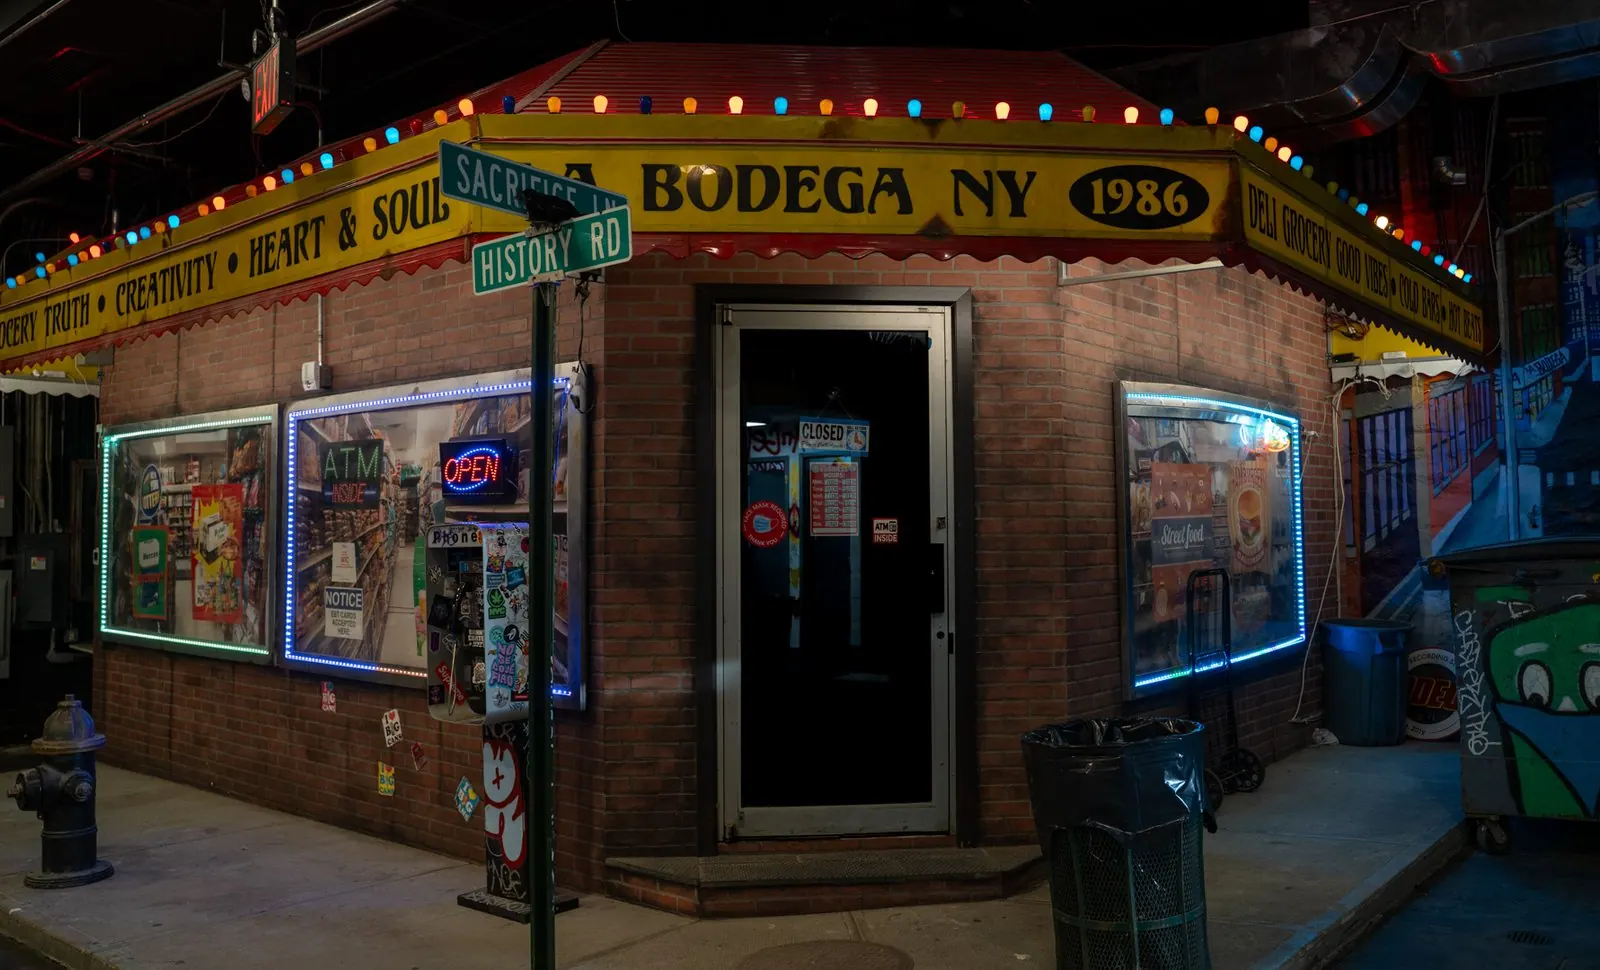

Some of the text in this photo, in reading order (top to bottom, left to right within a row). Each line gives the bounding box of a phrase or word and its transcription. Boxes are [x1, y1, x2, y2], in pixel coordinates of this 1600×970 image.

[255, 46, 279, 124] EXIT
[457, 154, 577, 209] SACRI
[641, 163, 914, 215] BODEGA
[951, 169, 1037, 218] NY
[1091, 178, 1189, 217] 1986
[44, 293, 90, 338] TRUTH
[116, 252, 217, 317] CREATIVITY
[249, 216, 326, 278] HEART
[338, 207, 358, 251] &
[373, 177, 450, 240] SOUL
[482, 217, 621, 287] HISTORY RD
[1248, 183, 1278, 241] DELI
[1283, 204, 1331, 269] GROCERY
[1336, 236, 1361, 285] GOOD
[1364, 252, 1388, 298] VIBES
[1400, 273, 1420, 314] COLD
[1421, 285, 1441, 325] BARS
[802, 423, 844, 441] CLOSED
[324, 445, 379, 480] ATM
[445, 455, 499, 482] OPEN
[331, 482, 367, 504] INSIDE
[874, 533, 897, 543] INSIDE
[1162, 523, 1205, 549] Street food
[326, 591, 362, 608] NOTICE
[322, 692, 336, 704] BIG
[384, 714, 389, 725] I
[385, 721, 400, 737] BIG
